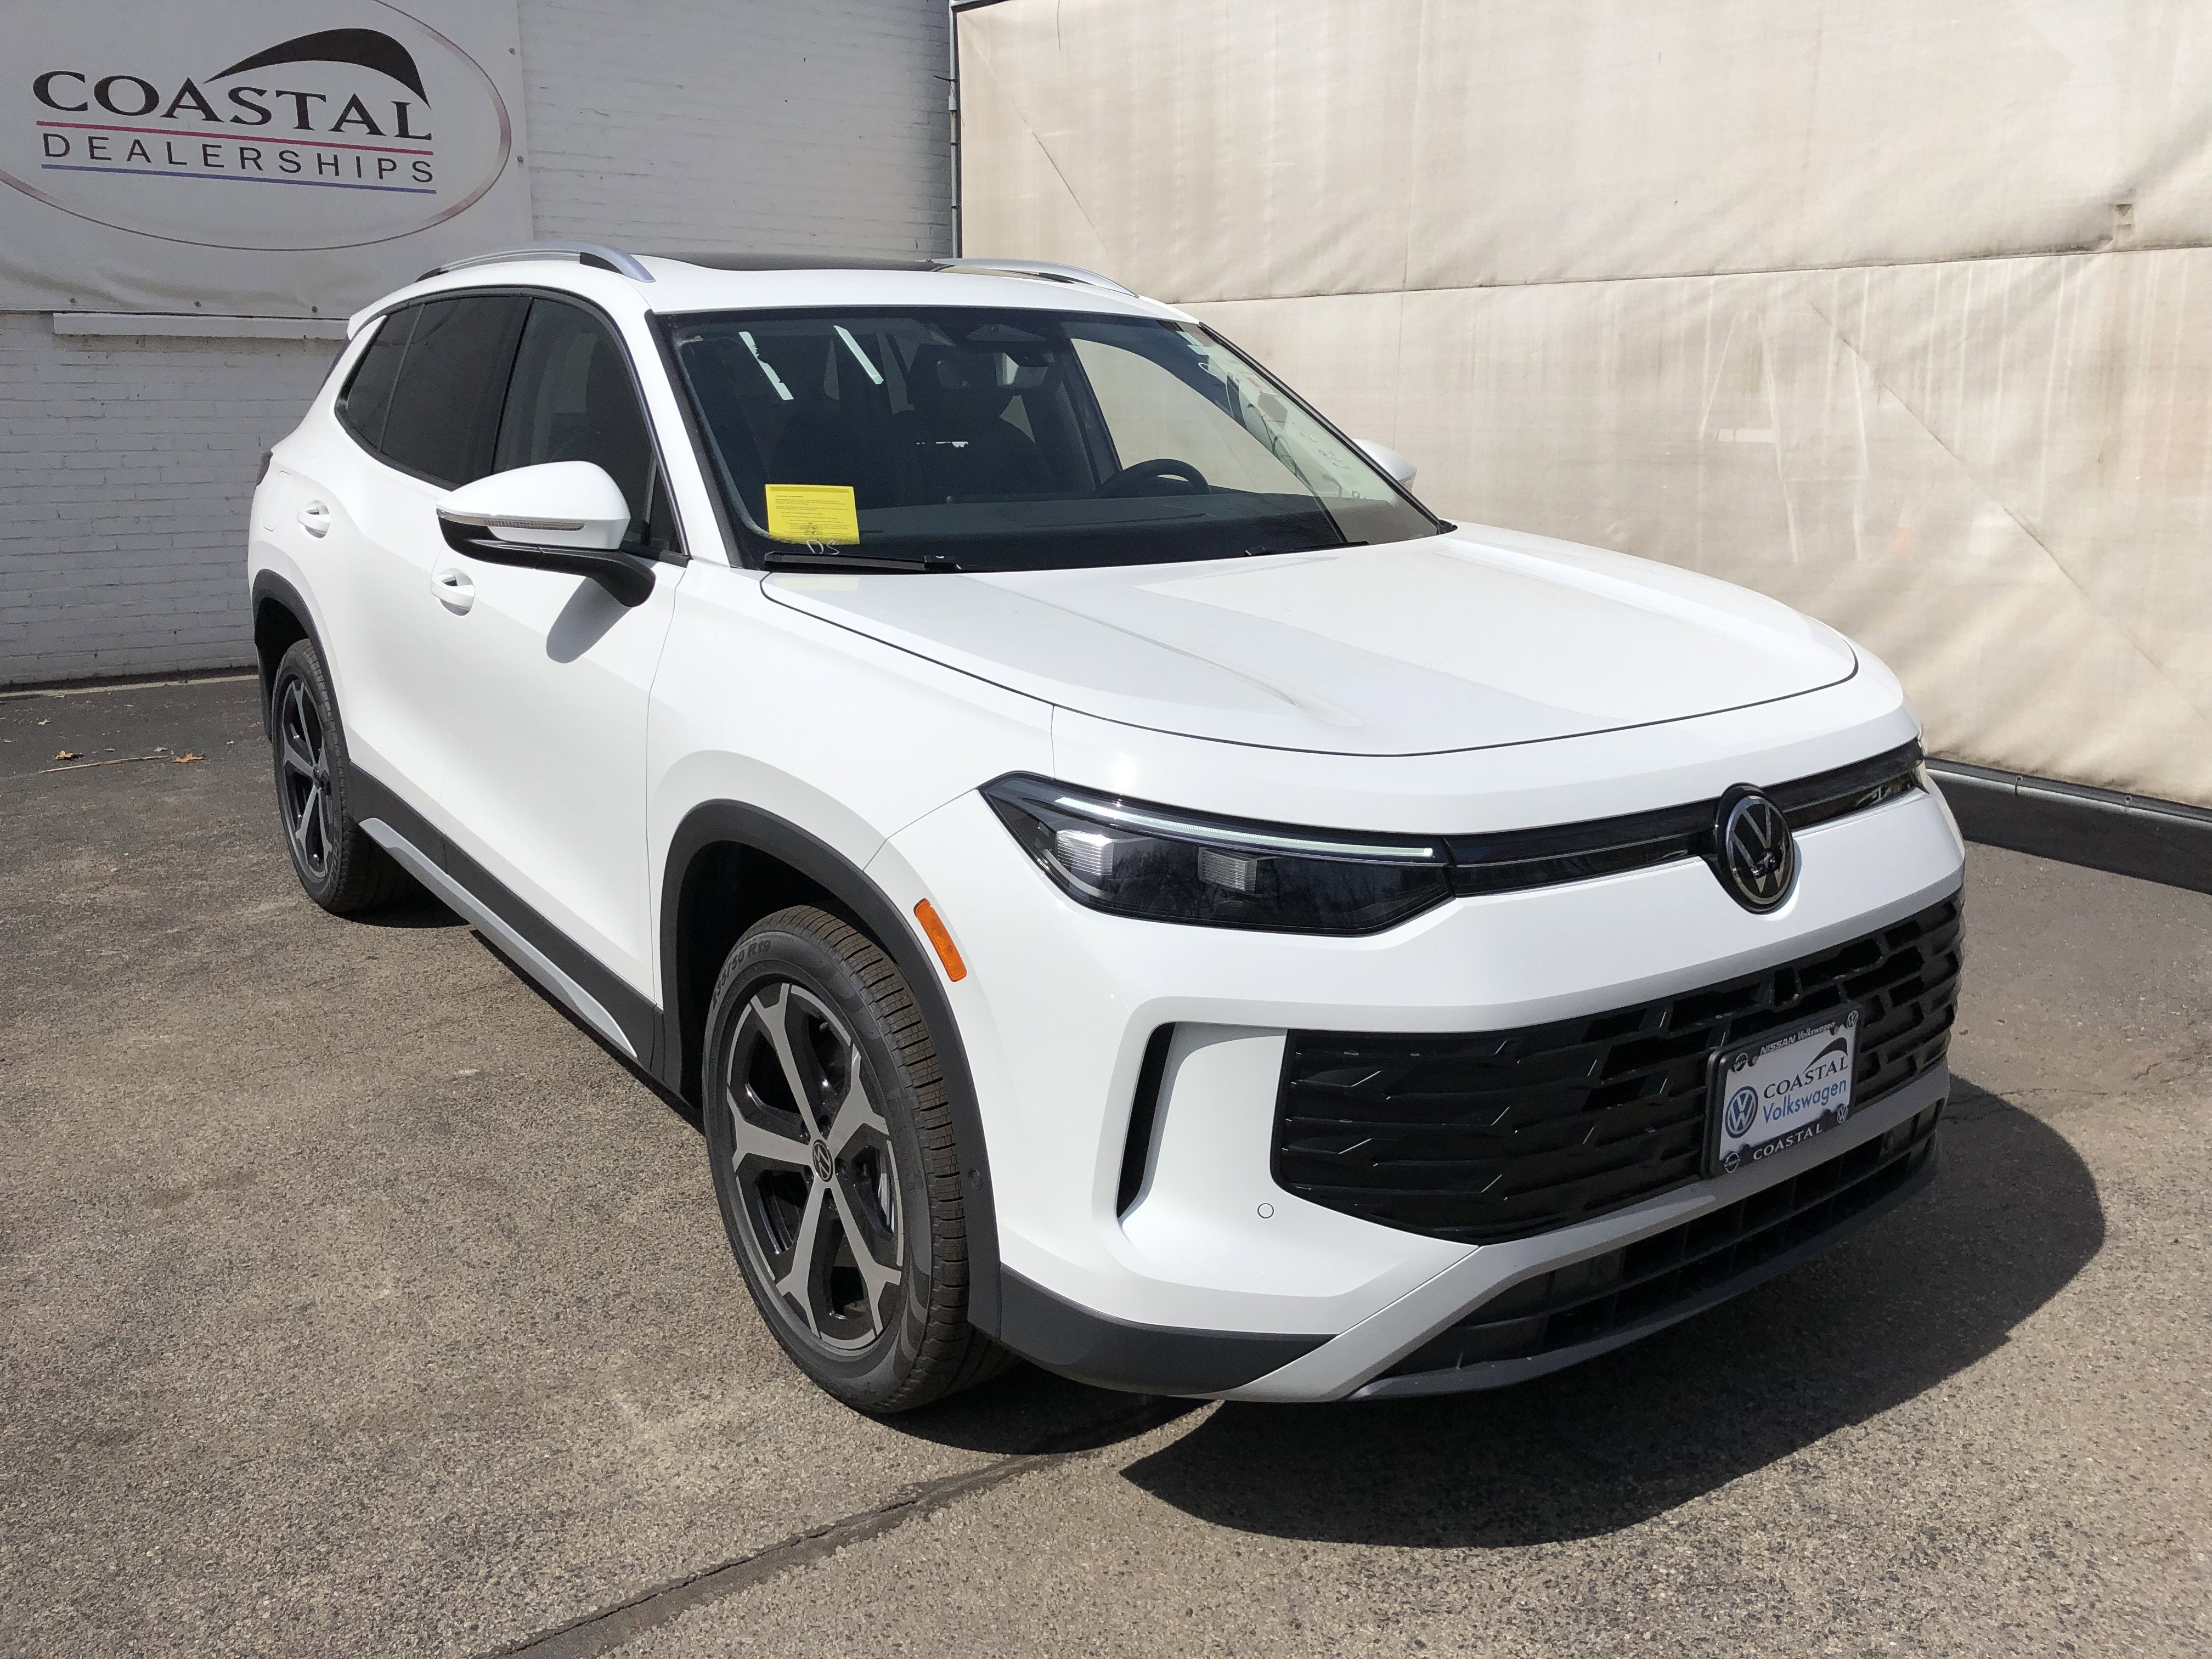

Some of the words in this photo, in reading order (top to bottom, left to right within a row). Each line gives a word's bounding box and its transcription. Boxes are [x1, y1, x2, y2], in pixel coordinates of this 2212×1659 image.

[32, 70, 432, 140] COASTAL
[42, 132, 433, 183] DEALERSHIPS
[747, 940, 771, 957] R19
[1760, 1035, 1796, 1055] NISSAN
[1797, 1021, 1835, 1040] Volkswagen
[1763, 1056, 1848, 1099] COASTAL
[1763, 1079, 1847, 1124] Volkswagen
[1753, 1124, 1823, 1160] COASTAL
